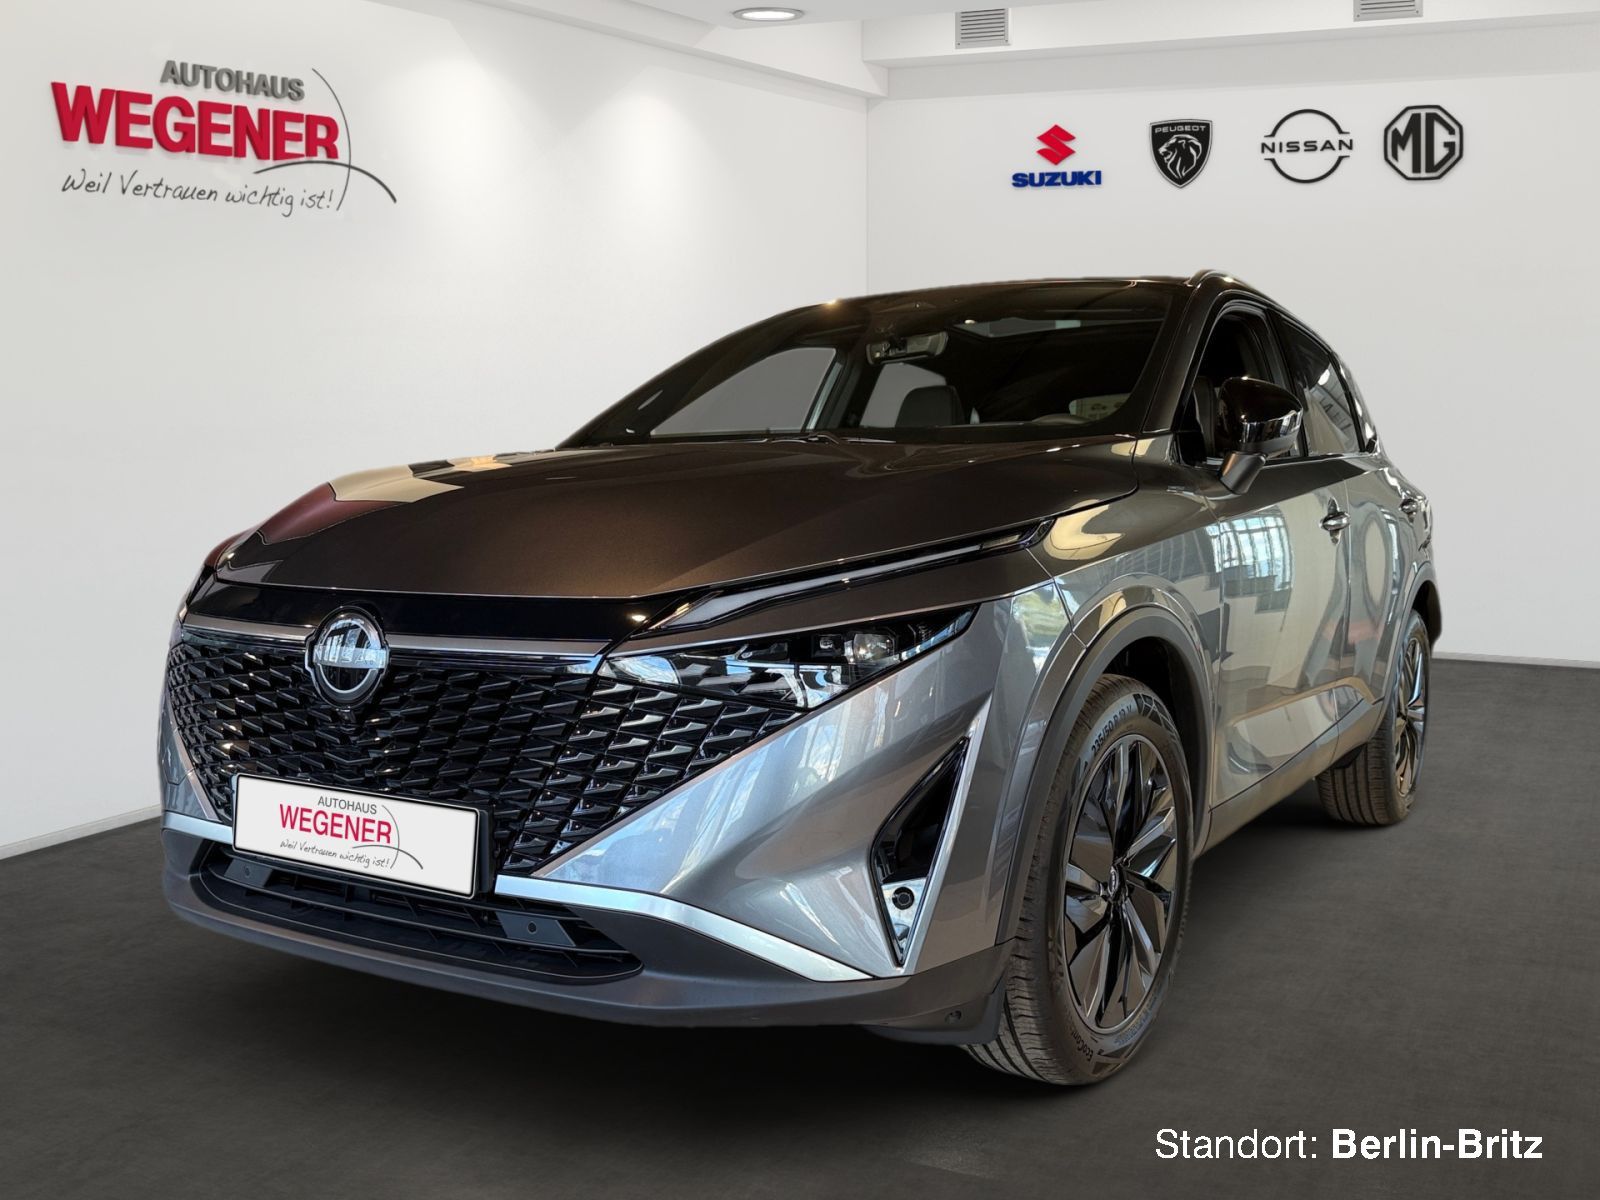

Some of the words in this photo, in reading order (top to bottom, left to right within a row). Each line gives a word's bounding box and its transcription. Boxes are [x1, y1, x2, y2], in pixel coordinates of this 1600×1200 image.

[160, 60, 305, 101] AUTOHAUS
[51, 82, 339, 161] WEGENER
[1155, 125, 1206, 133] PEUGEOT
[1261, 139, 1353, 154] NISSAN
[1391, 112, 1456, 174] MG
[61, 168, 112, 193] Weil
[120, 169, 218, 201] Vertrauen
[225, 184, 294, 217] wichtig
[300, 189, 334, 209] ist!
[1012, 170, 1102, 187] SUZUKI
[318, 796, 377, 815] AUTOHAUS
[280, 804, 392, 844] WEGENER
[280, 839, 298, 849] Weil
[300, 841, 337, 858] Vertrauen
[340, 850, 370, 869] wichtig
[372, 857, 390, 868] ist!
